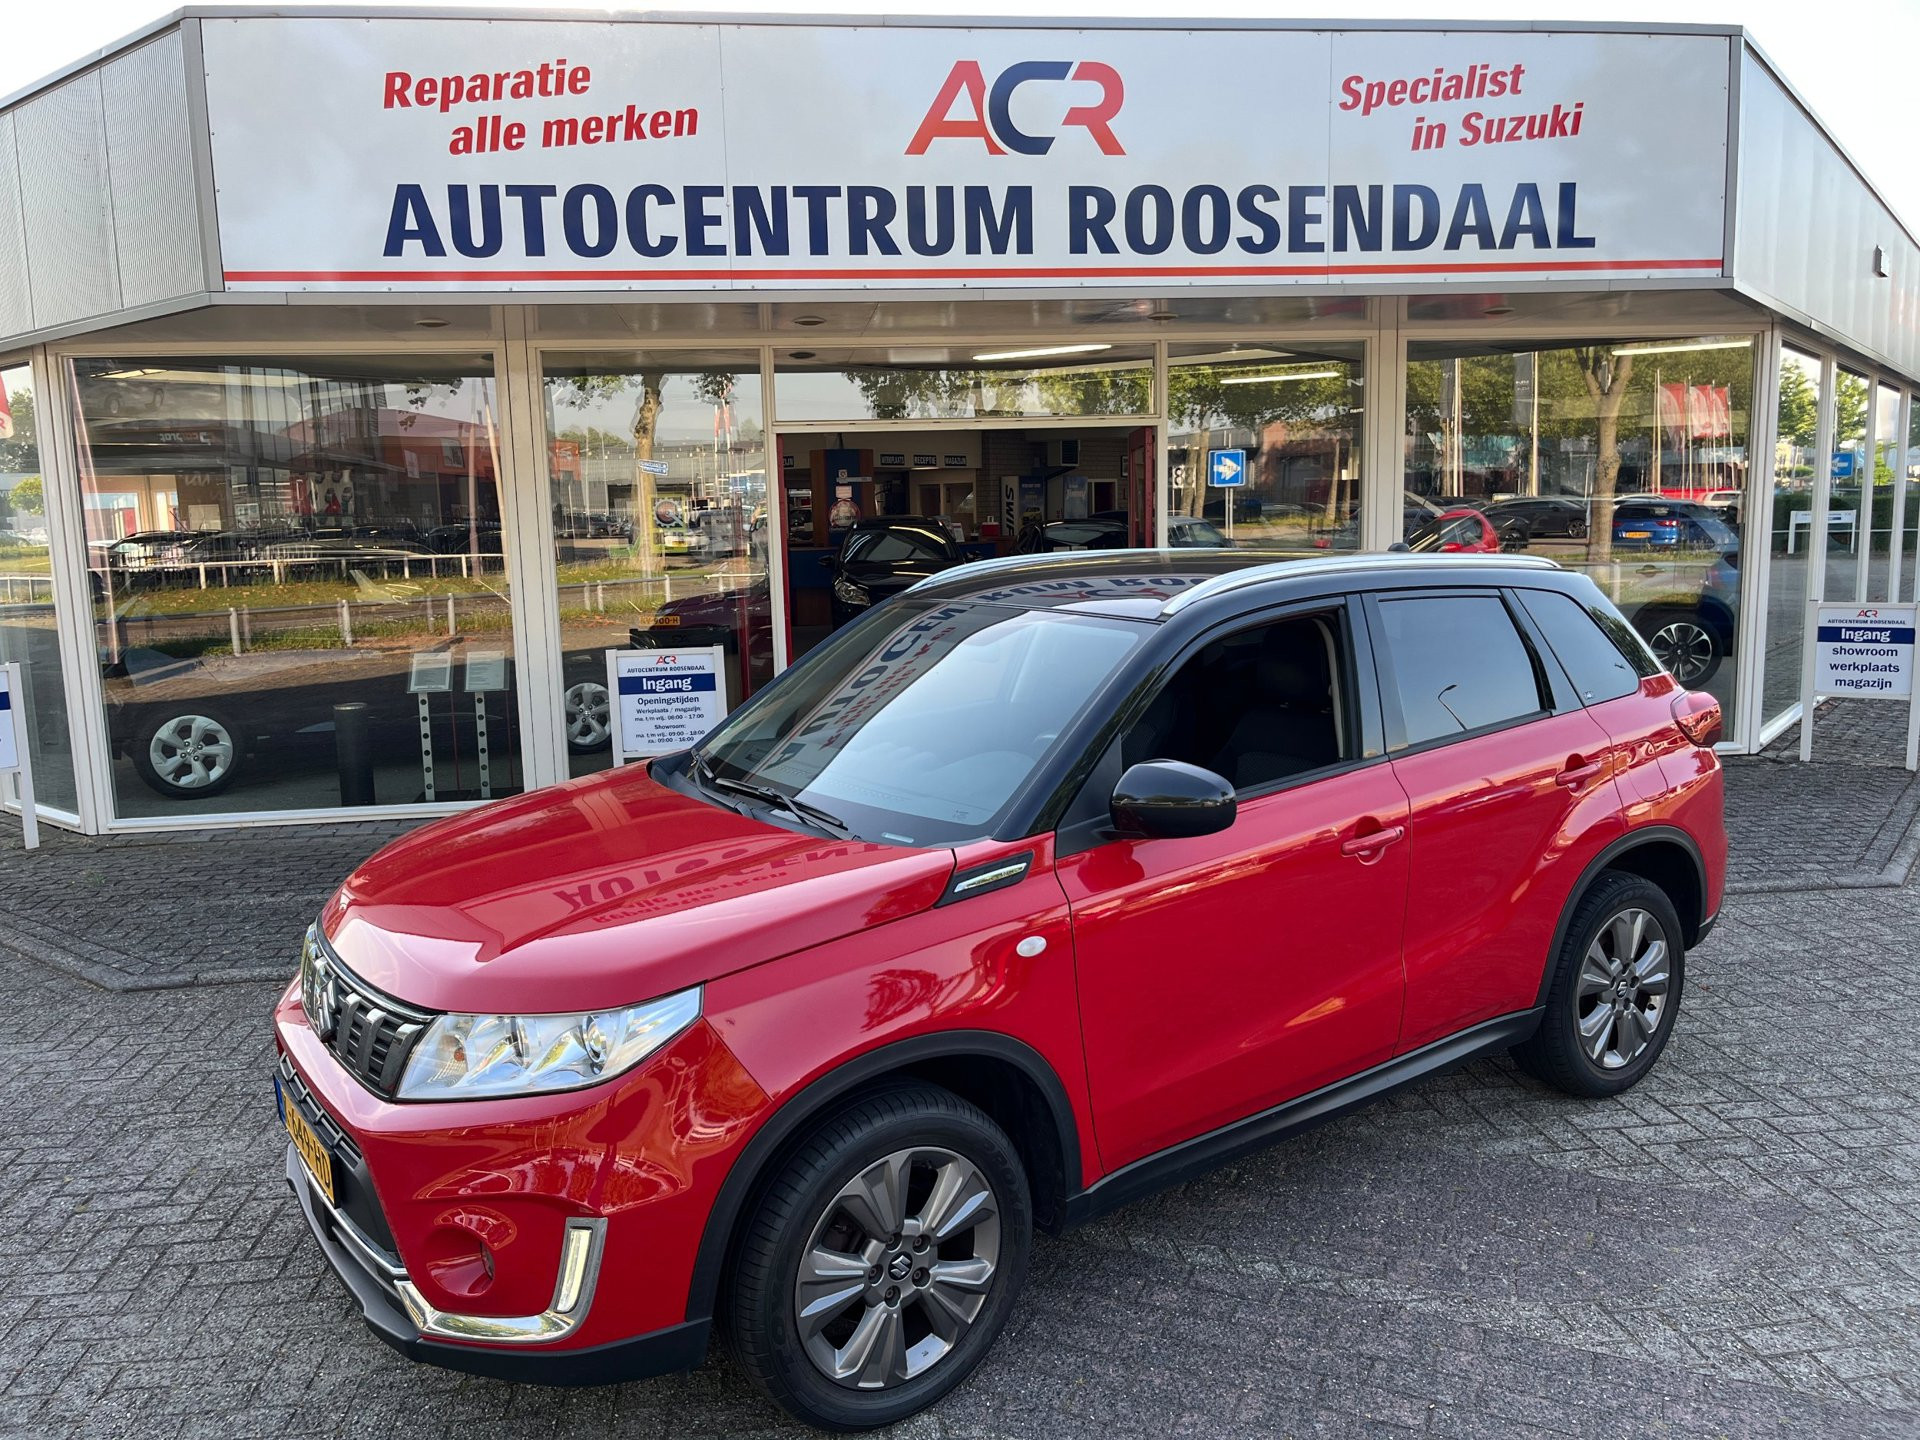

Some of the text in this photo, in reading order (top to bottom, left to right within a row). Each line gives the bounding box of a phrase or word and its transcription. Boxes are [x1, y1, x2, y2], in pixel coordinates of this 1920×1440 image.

[383, 58, 592, 112] Reparatie
[1338, 62, 1525, 116] Specialist
[905, 60, 1126, 156] ACR
[449, 104, 699, 156] alle merken
[1411, 102, 1584, 151] in Suzuki
[383, 181, 1596, 259] AUTOCENTRUM ROOSENDAAL
[914, 456, 936, 465] RECEPTIE
[1005, 484, 1015, 536] SWIF
[1857, 609, 1878, 618] ACR
[1841, 628, 1891, 642] Ingang
[1832, 646, 1898, 656] showroom
[656, 655, 677, 664] ACR
[1829, 662, 1900, 673] werkplaats
[642, 678, 692, 692] Ingang
[1835, 678, 1892, 690] magazijn
[637, 696, 700, 706] Openingstijden
